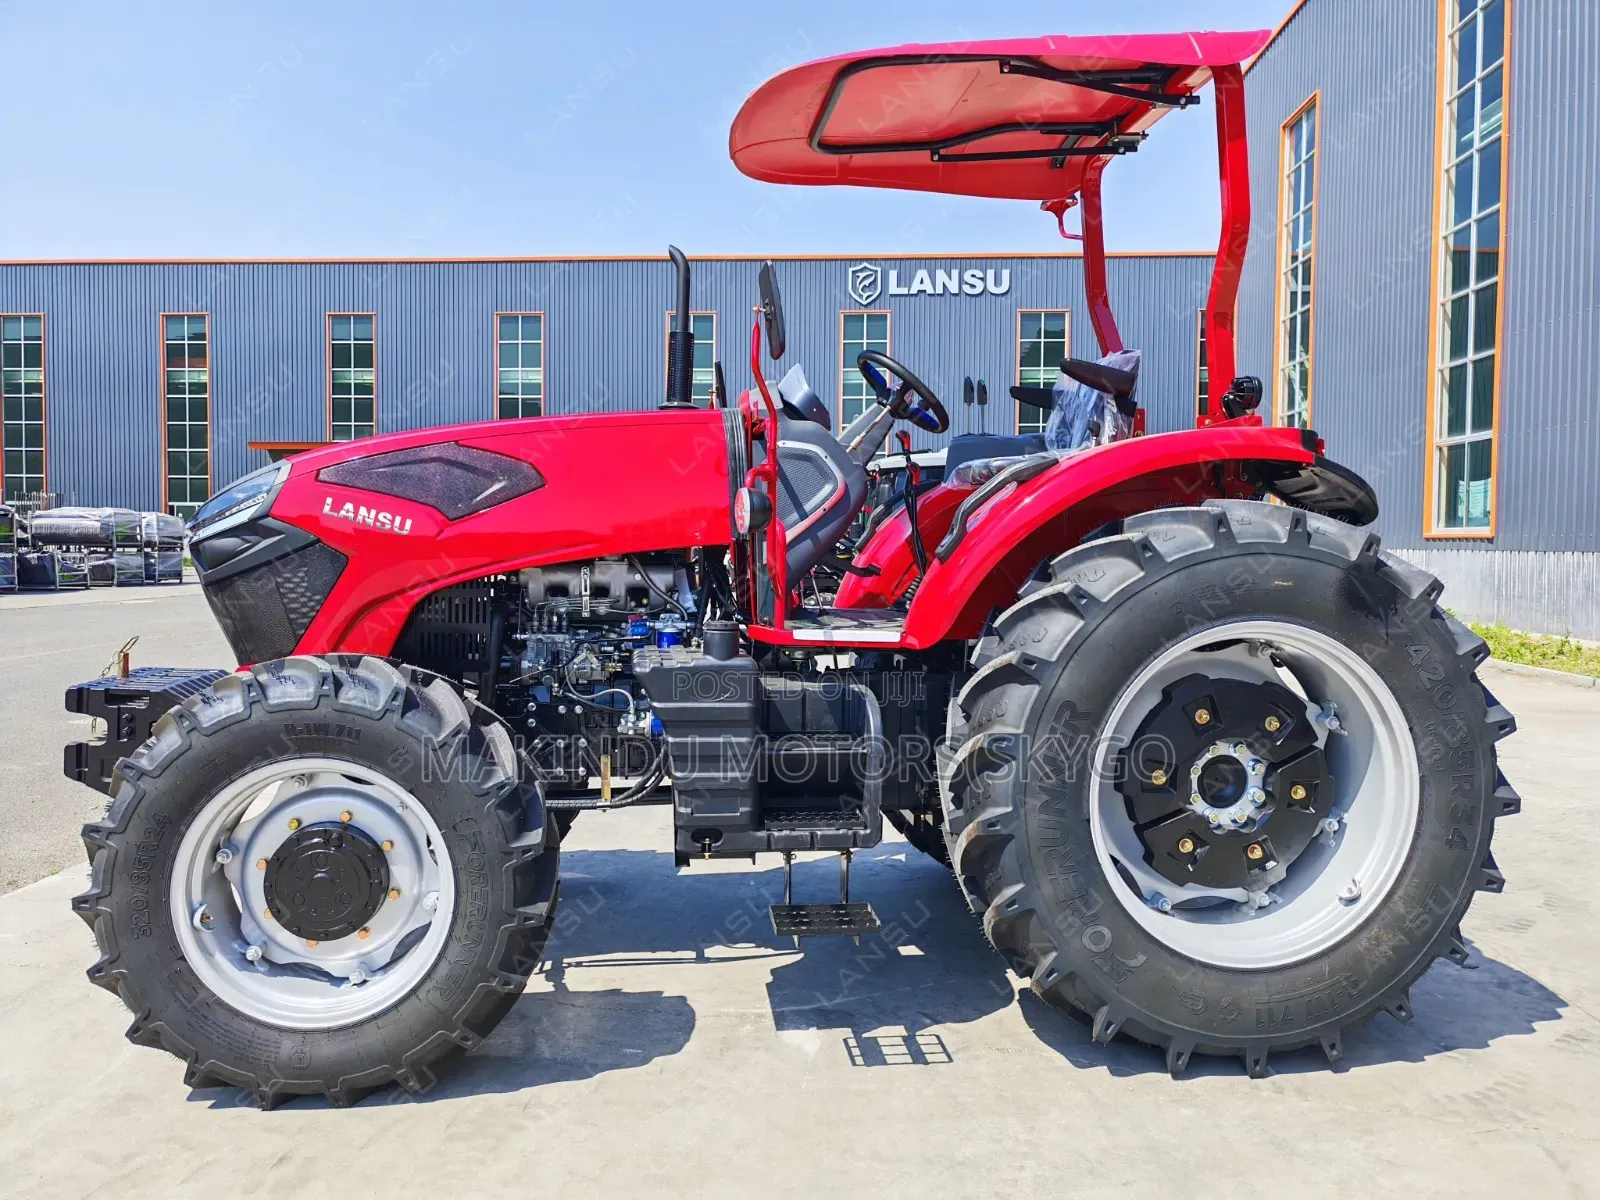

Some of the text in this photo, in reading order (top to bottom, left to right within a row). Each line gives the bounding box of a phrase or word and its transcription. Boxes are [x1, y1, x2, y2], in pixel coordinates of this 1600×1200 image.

[889, 269, 1010, 296] LANSU
[323, 497, 412, 535] LANSU
[1405, 643, 1475, 851] 420/85R34
[129, 811, 172, 940] 320/85R24
[433, 825, 489, 1002] FORERUNNER
